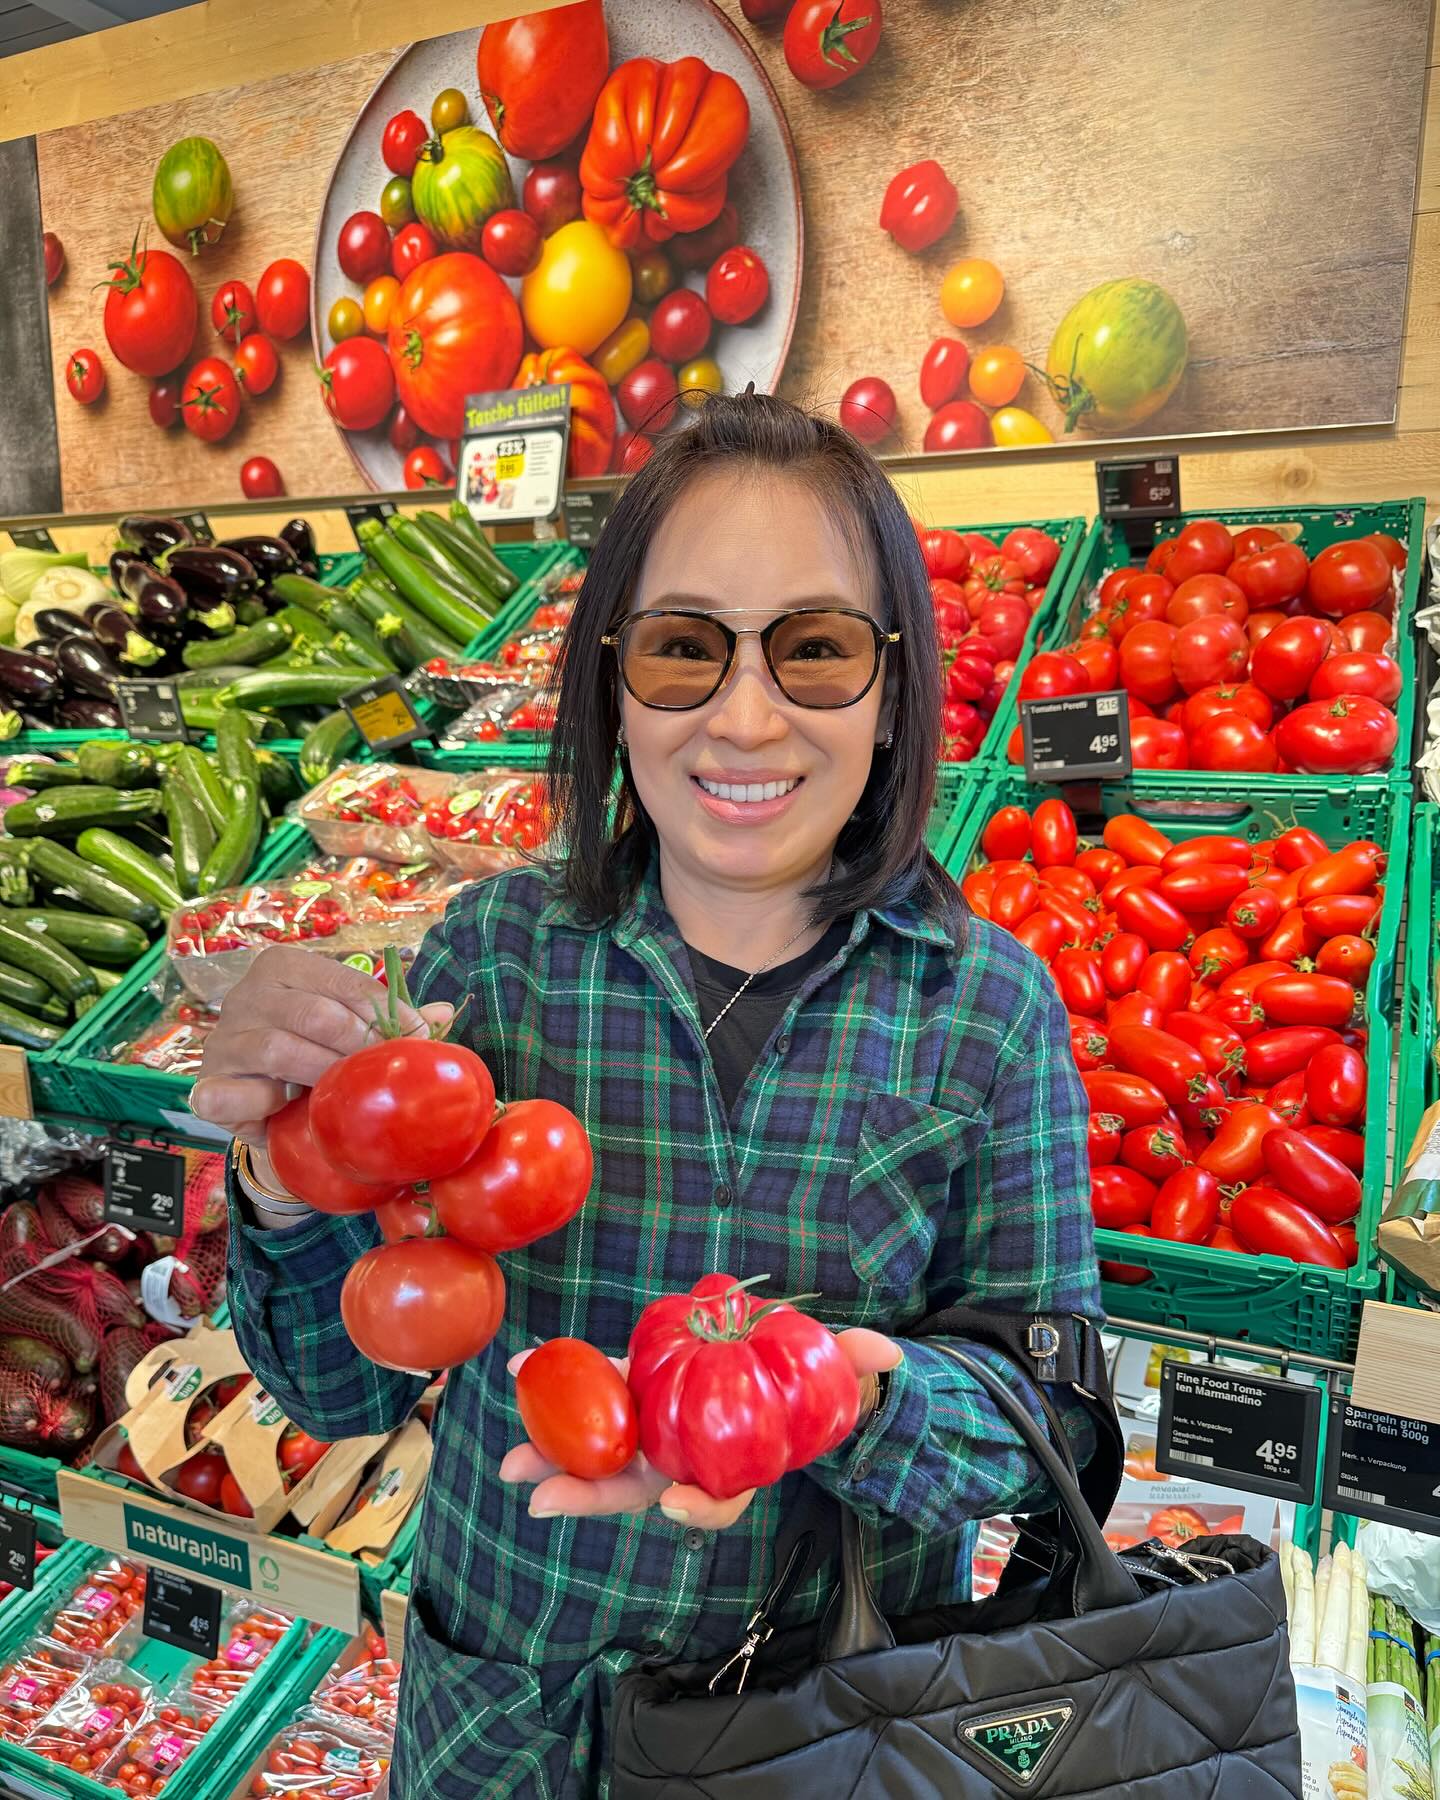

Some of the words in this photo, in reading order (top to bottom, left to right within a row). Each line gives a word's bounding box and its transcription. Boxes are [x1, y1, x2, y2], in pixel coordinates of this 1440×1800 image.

[466, 402, 514, 429] Tasche
[517, 386, 567, 416] füllen!
[1031, 703, 1062, 715] Tomaten
[1098, 700, 1119, 712] 215
[1089, 734, 1119, 754] 4.95
[1175, 1382, 1193, 1394] ten
[1194, 1387, 1262, 1407] Marmandino
[1176, 1372, 1200, 1385] Fine
[1201, 1377, 1229, 1391] Food
[1232, 1382, 1267, 1397] Toma-
[1173, 1415, 1189, 1425] Herk.
[1196, 1420, 1233, 1434] Verpackung
[1344, 1418, 1374, 1431] extra
[1376, 1424, 1398, 1436] fein
[1402, 1430, 1430, 1445] 500g
[1345, 1406, 1397, 1426] Spargeln
[1400, 1420, 1428, 1432] grün
[1256, 1439, 1297, 1465] 4.95
[1341, 1451, 1359, 1461] Herk.
[1367, 1456, 1407, 1472] Verpackung
[1340, 1472, 1359, 1482] Stück
[132, 1519, 243, 1573] naturaplan
[986, 1717, 1055, 1743] PRADA
[1009, 1735, 1033, 1745] MILANO
